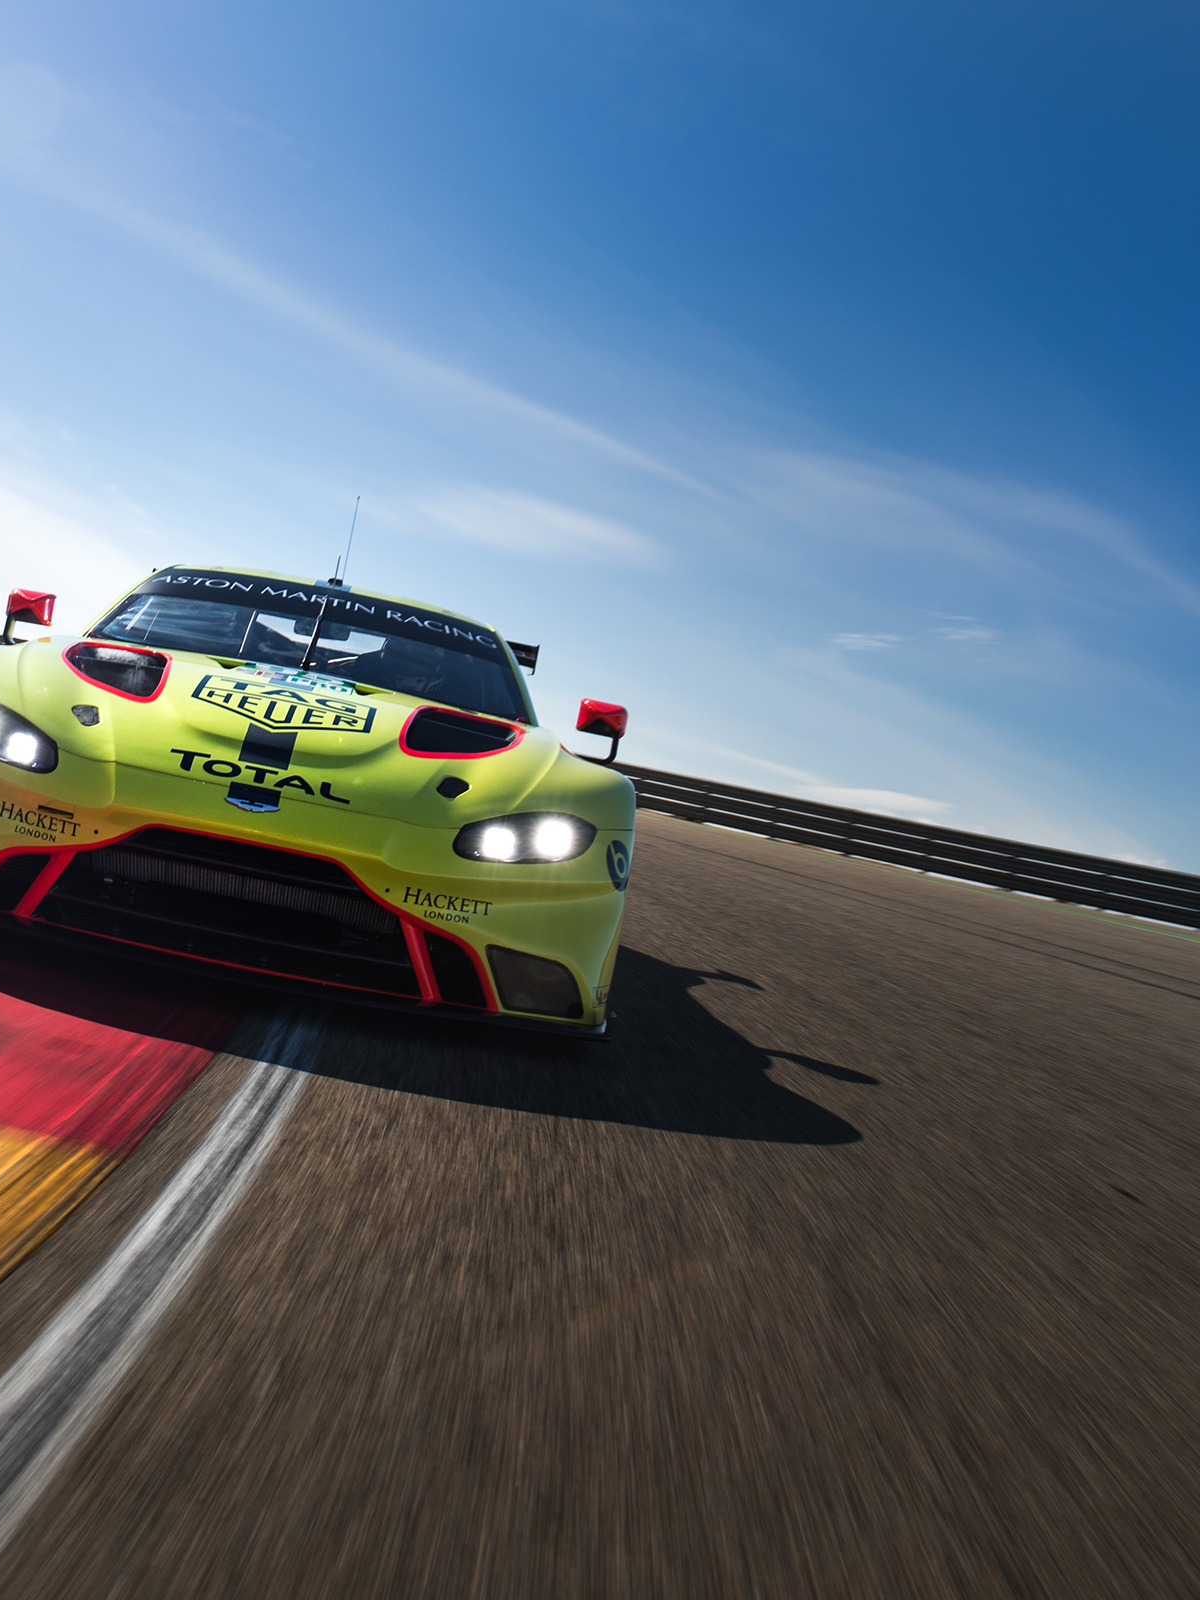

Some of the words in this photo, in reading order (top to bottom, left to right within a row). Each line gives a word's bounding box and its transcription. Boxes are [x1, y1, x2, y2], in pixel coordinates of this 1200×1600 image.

[152, 575, 254, 592] ASTON
[260, 586, 376, 615] MARTIN
[386, 609, 497, 649] RACING
[206, 690, 360, 728] HEUER
[220, 678, 358, 714] TAG
[170, 748, 351, 805] TOTAL
[14, 825, 57, 843] LONDON
[402, 886, 493, 916] HACKETT
[423, 910, 470, 924] LONDON
